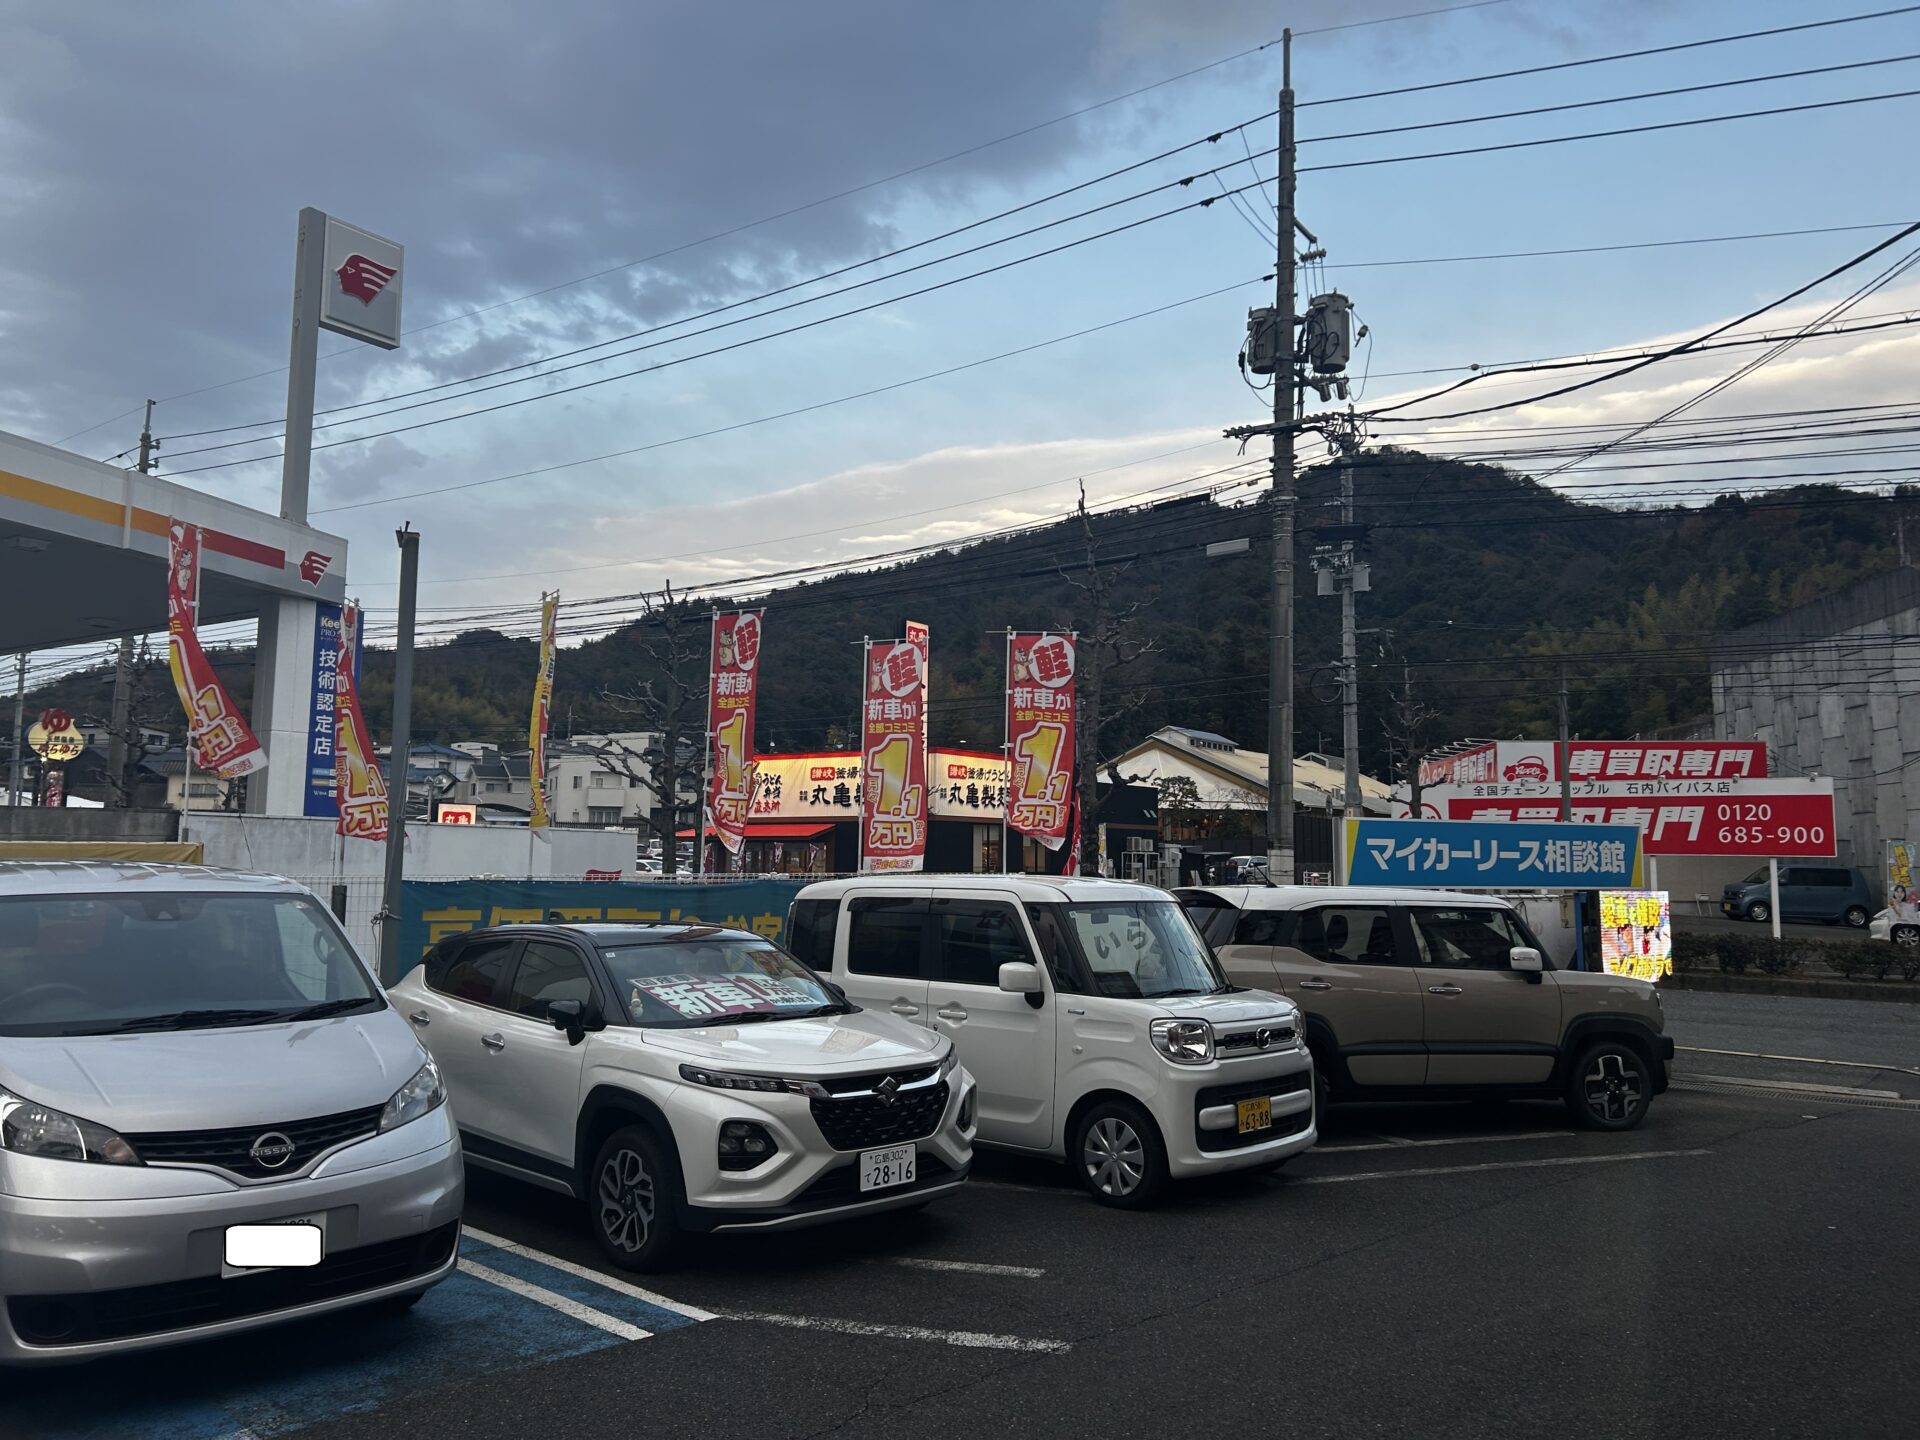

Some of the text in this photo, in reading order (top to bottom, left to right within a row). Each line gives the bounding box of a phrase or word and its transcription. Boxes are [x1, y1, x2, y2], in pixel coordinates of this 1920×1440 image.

[735, 617, 759, 666] 軽
[886, 646, 920, 692] 軽
[1032, 640, 1073, 683] 軽
[313, 648, 338, 756] 技術認定店
[868, 698, 917, 721] 新車が
[1013, 687, 1071, 711] 新車が
[868, 722, 916, 734] 全部コミコミ
[1015, 711, 1070, 722] 全部コミコミ
[836, 767, 865, 779] 釜揚
[867, 733, 922, 818] 1.1
[1014, 722, 1070, 803] 1.1
[1568, 749, 1754, 776] 車買取専門
[762, 773, 782, 786] うどん
[1473, 785, 1550, 797] 全国チェーン
[1626, 781, 1731, 795] 石内バイパス店
[344, 802, 388, 833] 万円
[1011, 803, 1057, 830] 万円
[1717, 804, 1772, 821] 0120
[869, 819, 915, 848] 万円
[1718, 826, 1825, 844] 685-900
[1365, 837, 1626, 874] マイカーリース相談館
[650, 980, 766, 1016] 新車
[1245, 1110, 1270, 1130] 63-88
[250, 1144, 296, 1158] NISSAN
[873, 1161, 913, 1187] 28-16
